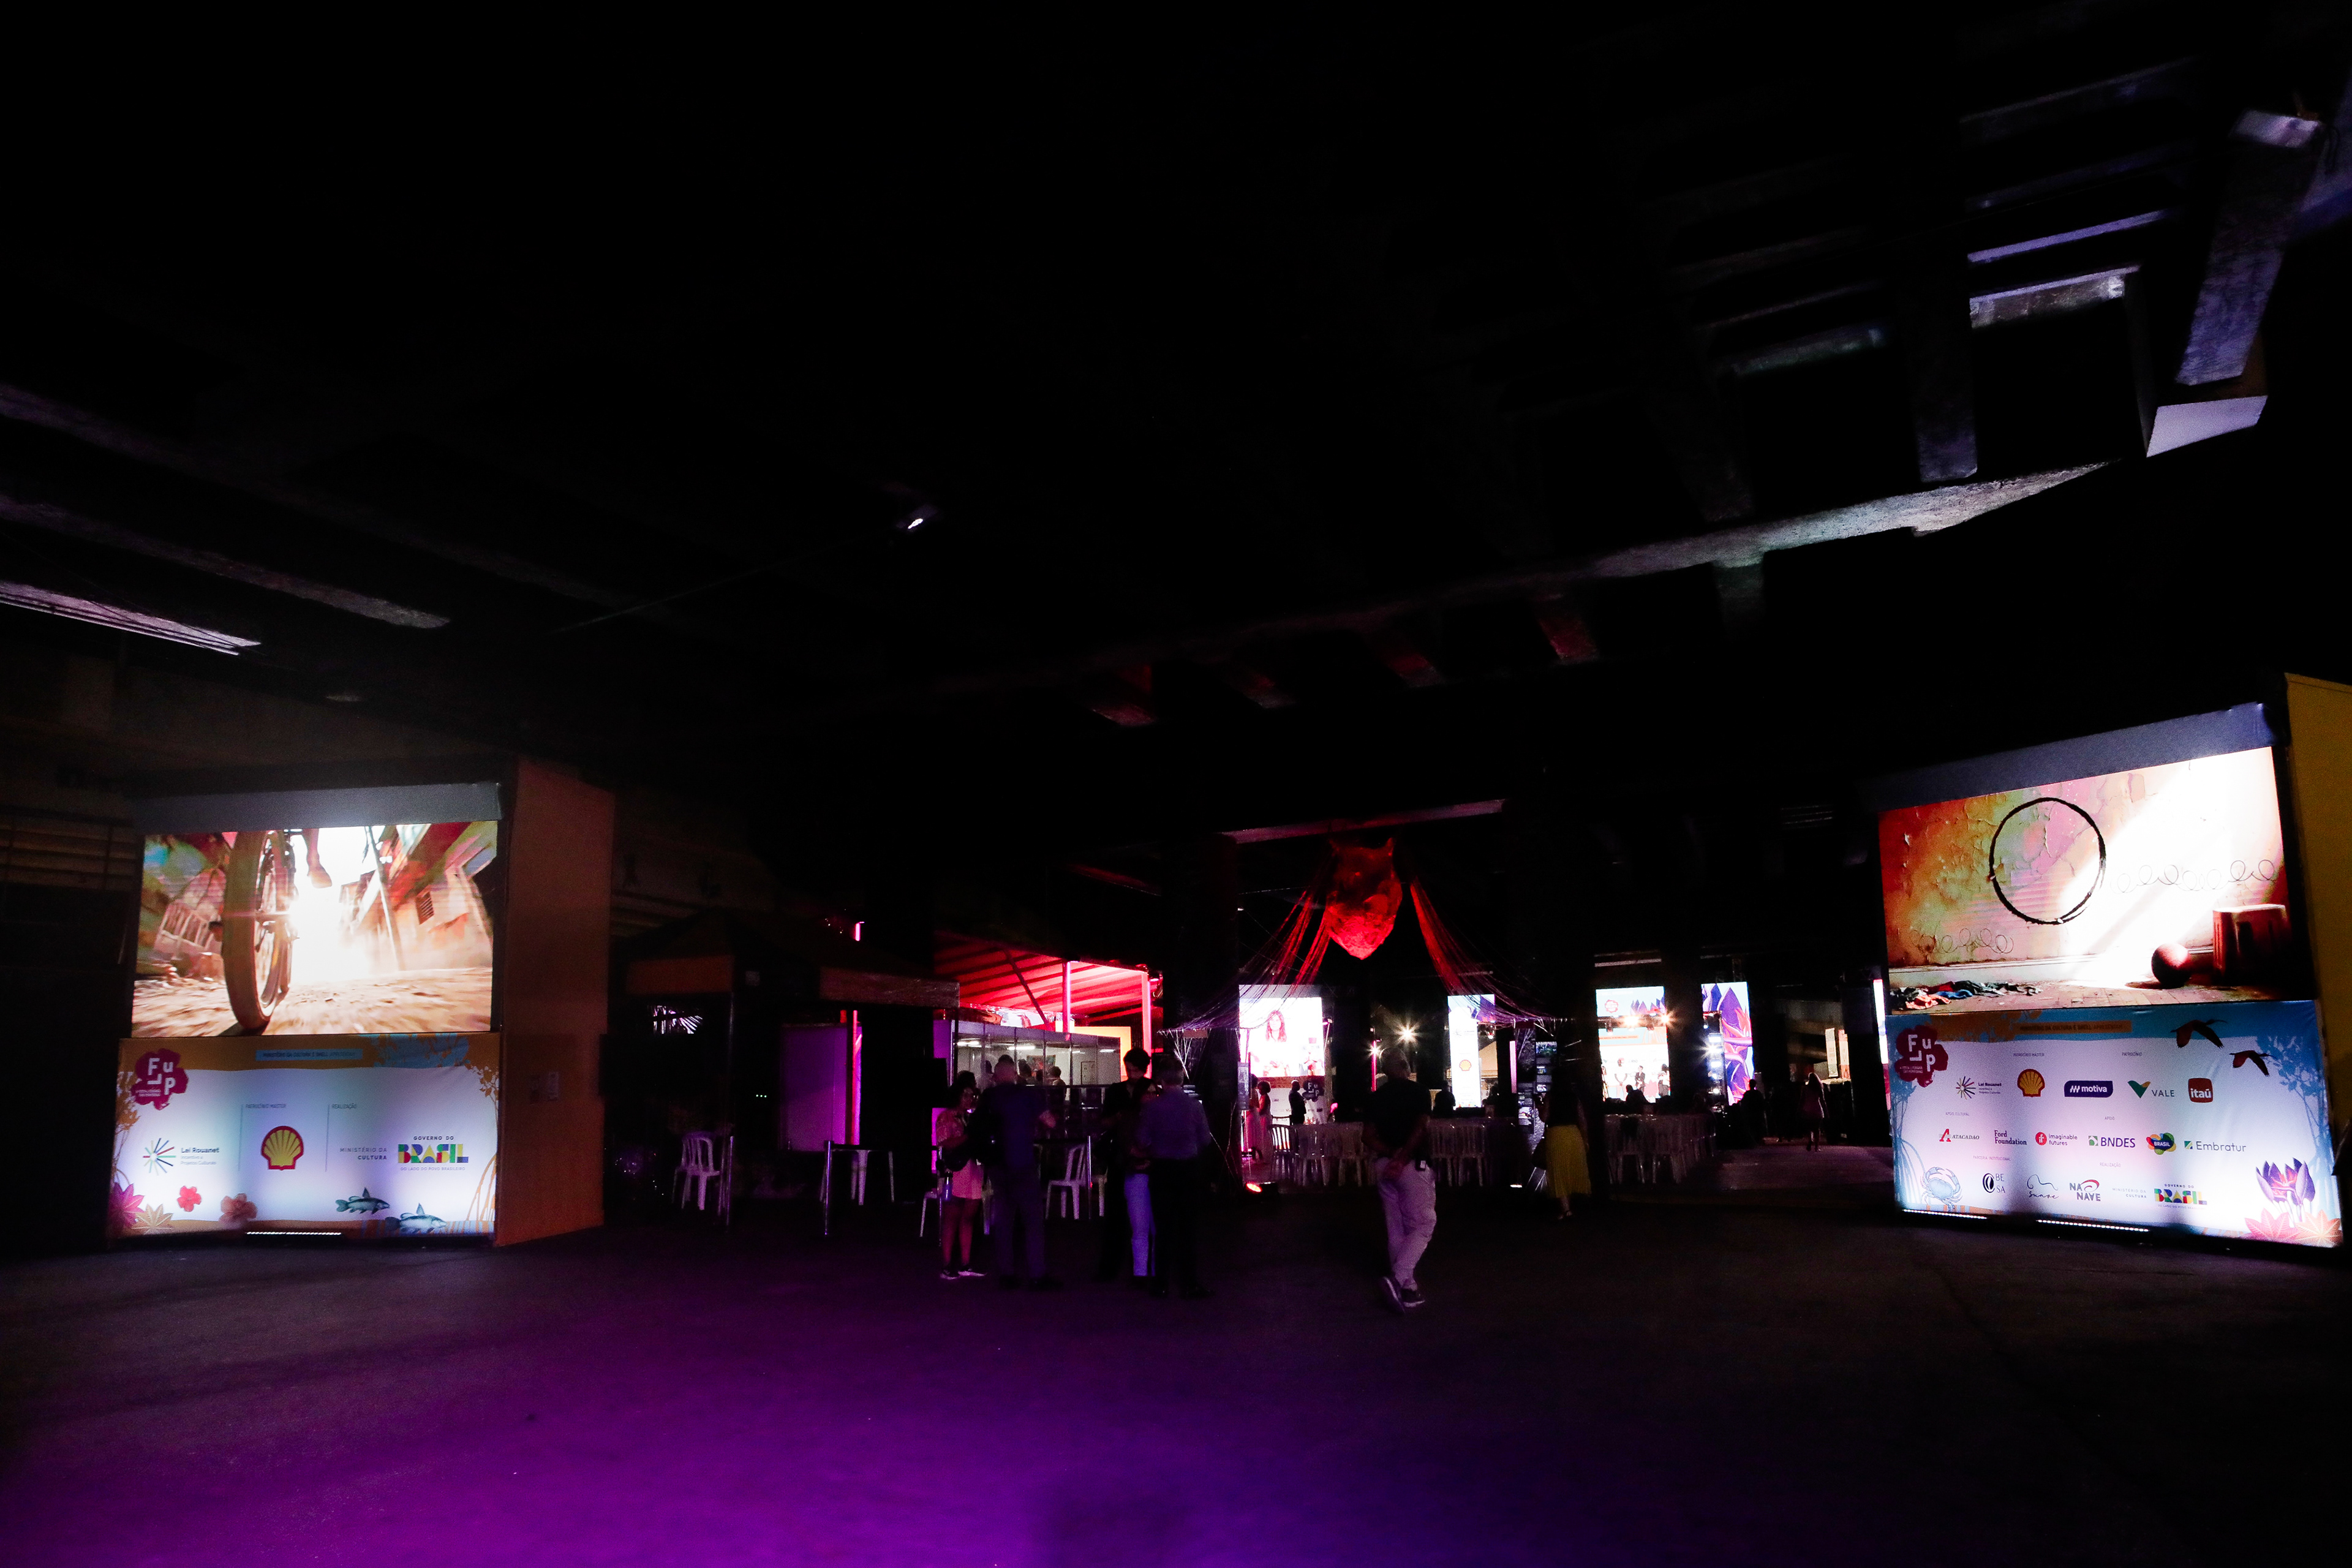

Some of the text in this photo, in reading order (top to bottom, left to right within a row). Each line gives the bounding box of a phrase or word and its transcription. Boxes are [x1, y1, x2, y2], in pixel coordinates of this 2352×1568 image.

[2190, 1088, 2212, 1098] itaú
[2101, 1137, 2136, 1148] BNDES
[2196, 1141, 2247, 1152] Embratur
[398, 1144, 469, 1163] BRASIL
[2069, 1182, 2082, 1191] NA
[2076, 1192, 2101, 1202] NAVE
[2154, 1188, 2207, 1205] BRASIL
